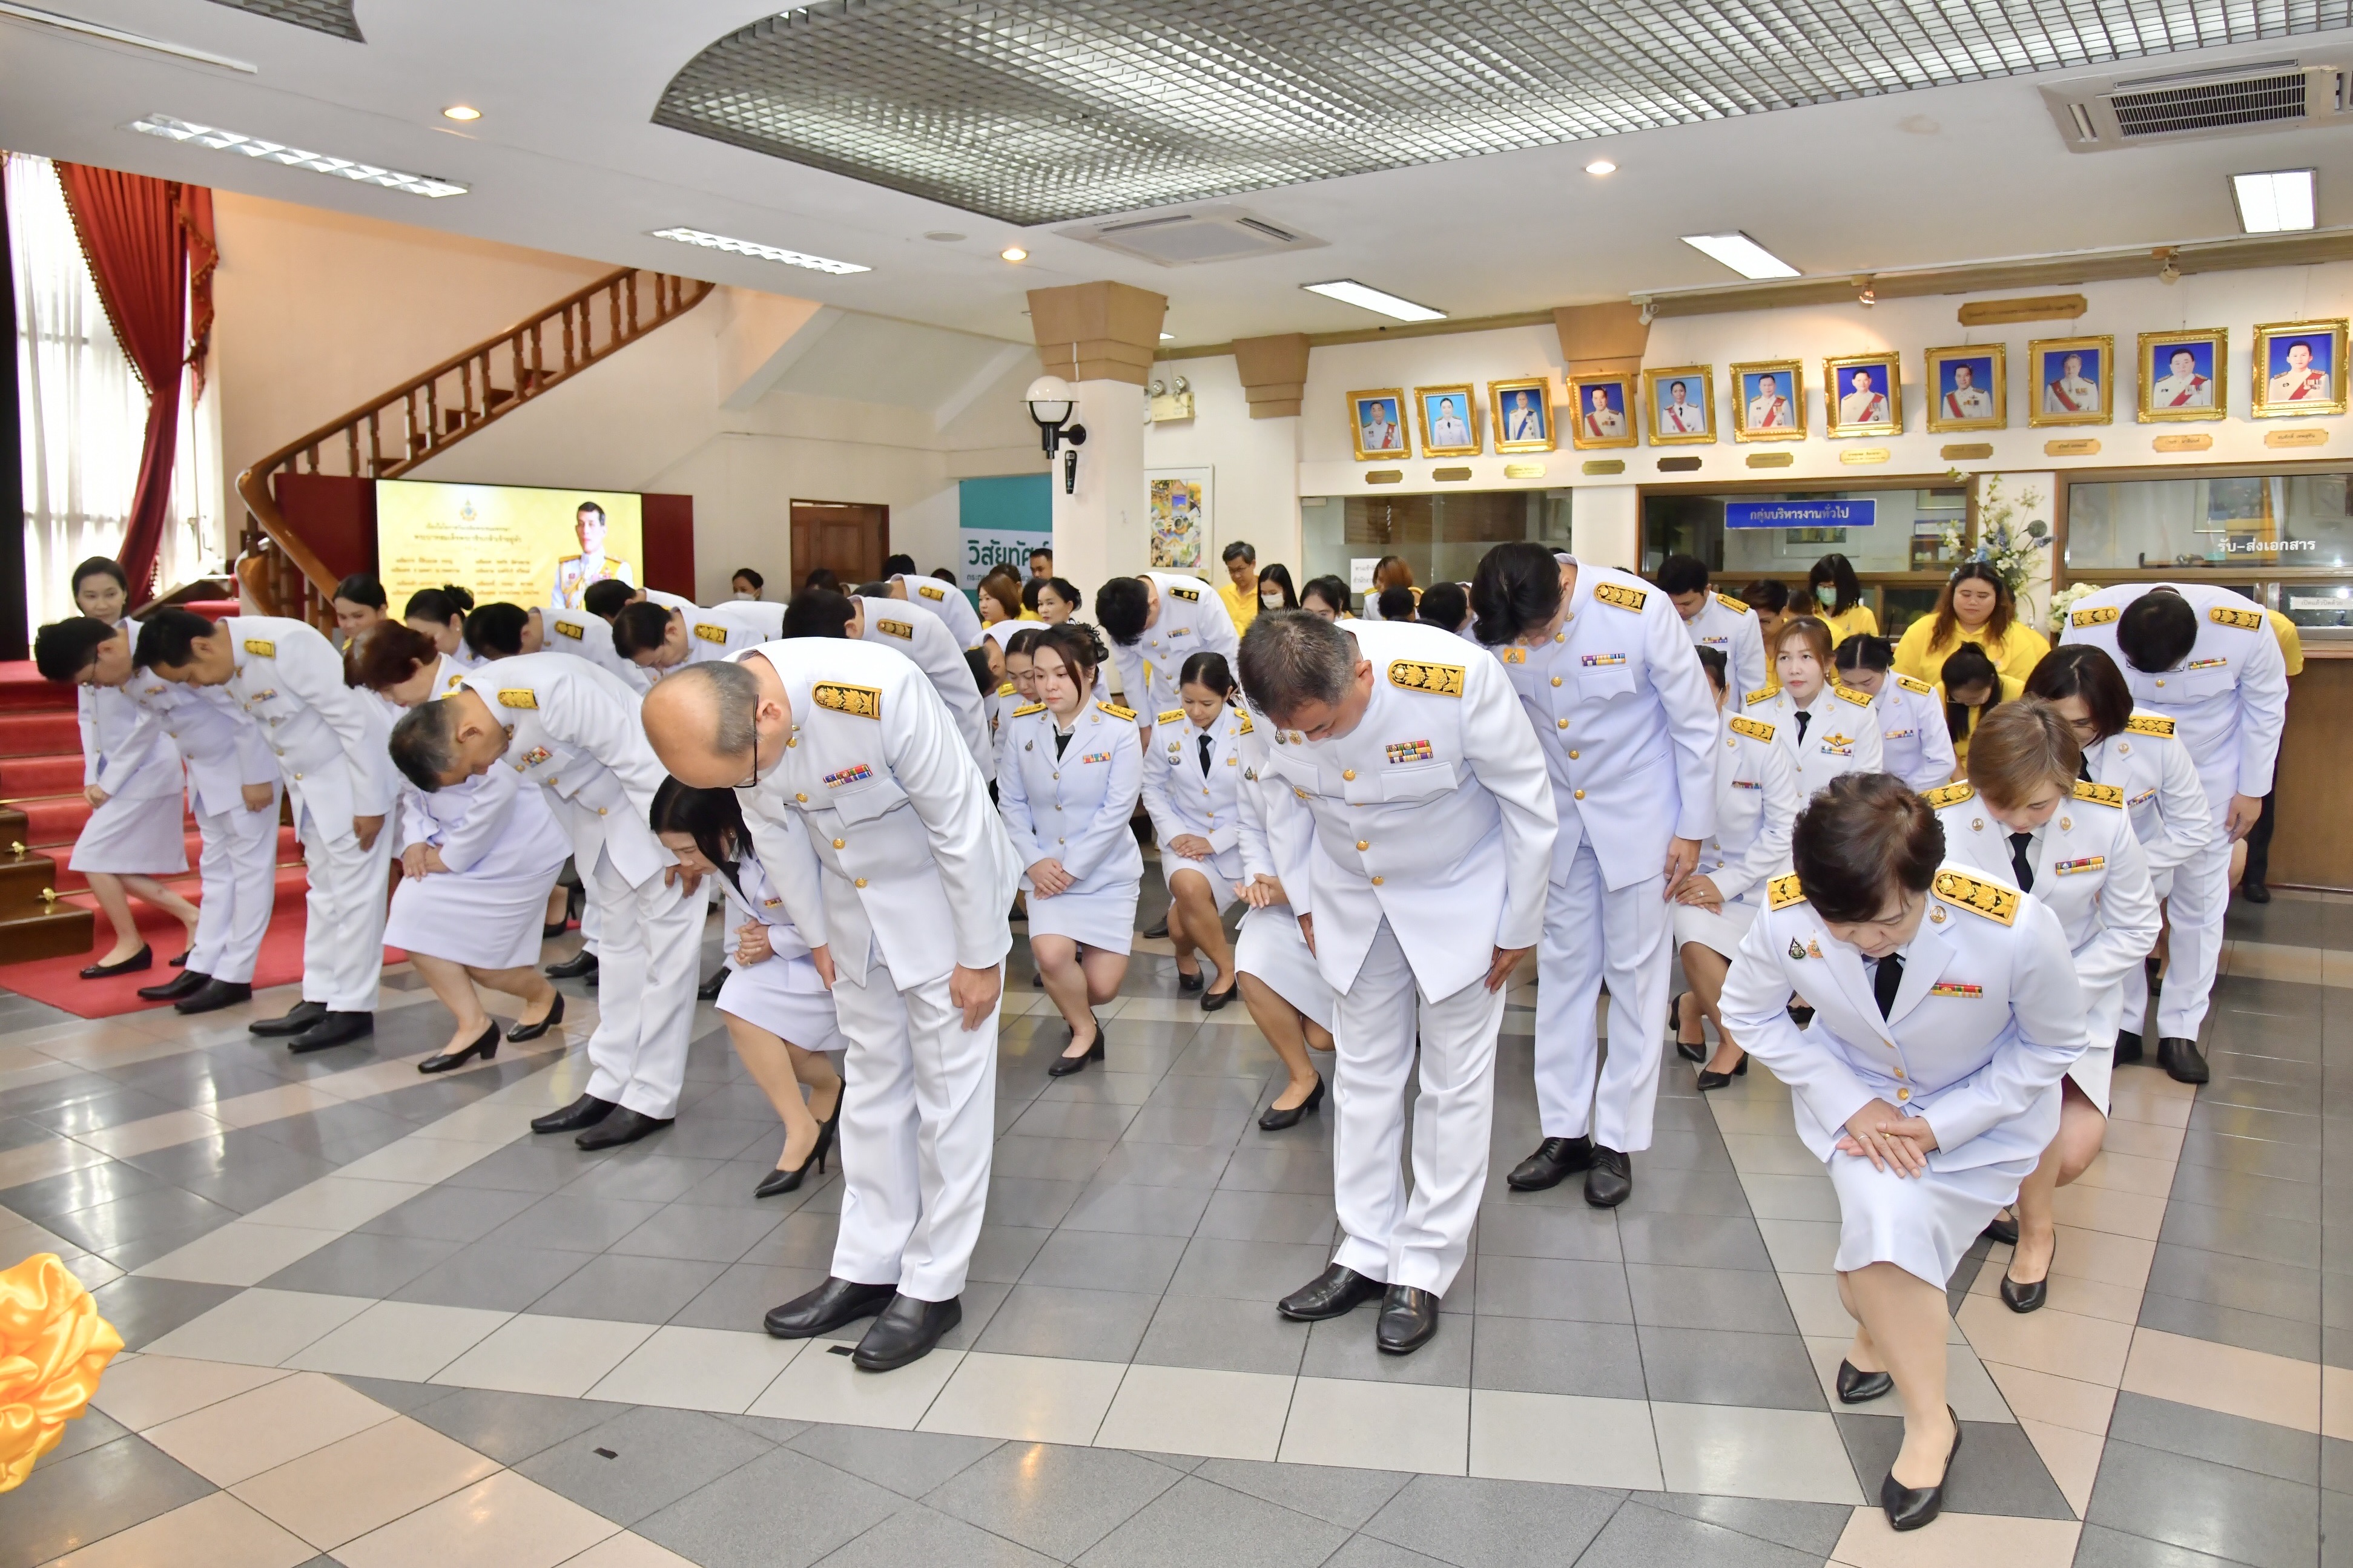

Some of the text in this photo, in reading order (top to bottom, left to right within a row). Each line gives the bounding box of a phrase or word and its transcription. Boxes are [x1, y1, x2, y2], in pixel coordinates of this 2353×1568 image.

[1750, 504, 1849, 523] กลุ่มบริหารงานทั่วไป
[2217, 538, 2316, 552] รับ-ส่งเอกสาร
